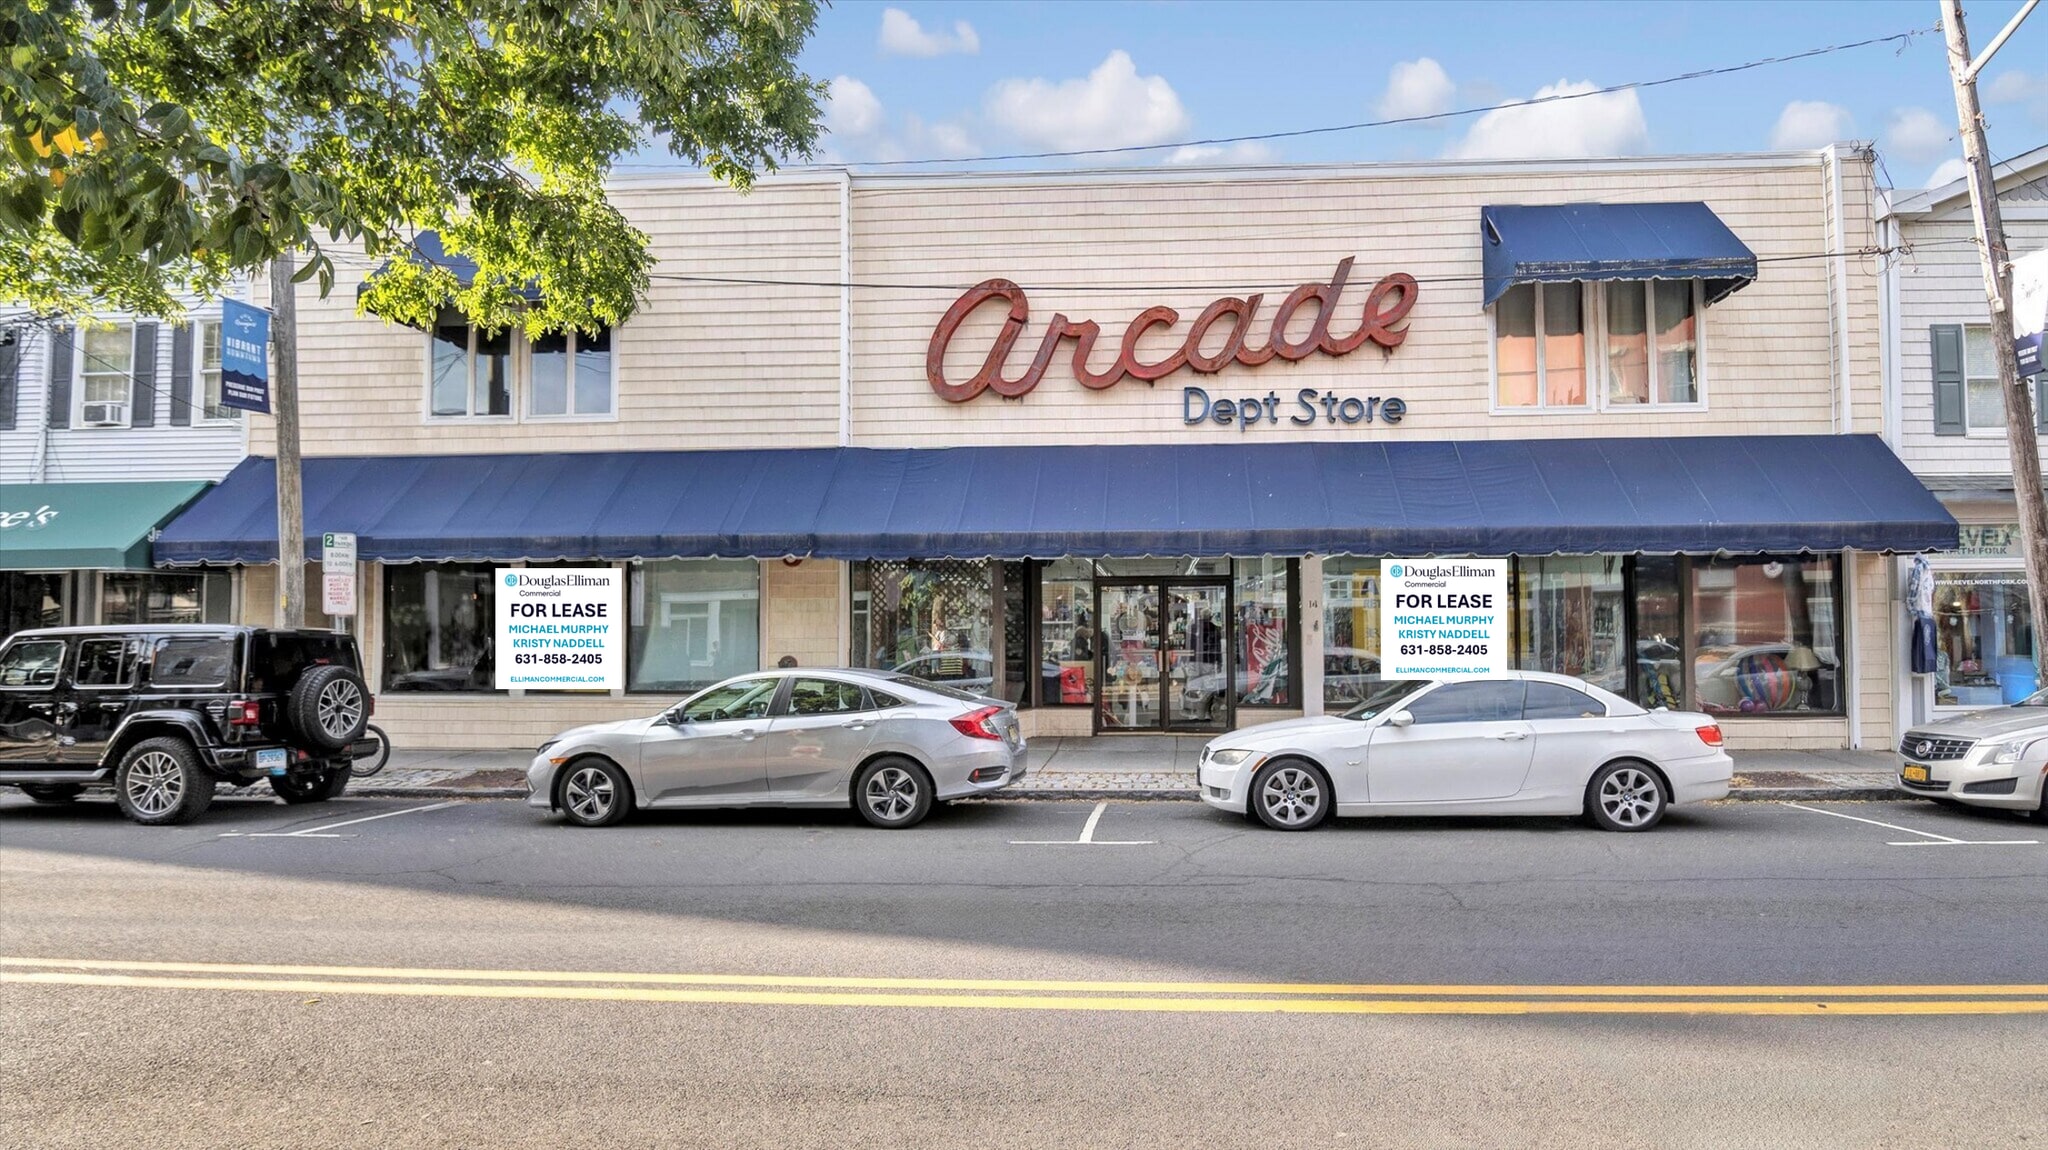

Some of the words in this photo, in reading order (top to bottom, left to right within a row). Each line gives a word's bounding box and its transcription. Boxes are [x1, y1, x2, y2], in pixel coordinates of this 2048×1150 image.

[926, 255, 1419, 403] Arcade
[1183, 386, 1281, 432] Dept
[1290, 387, 1408, 426] Store
[326, 535, 333, 546] 2
